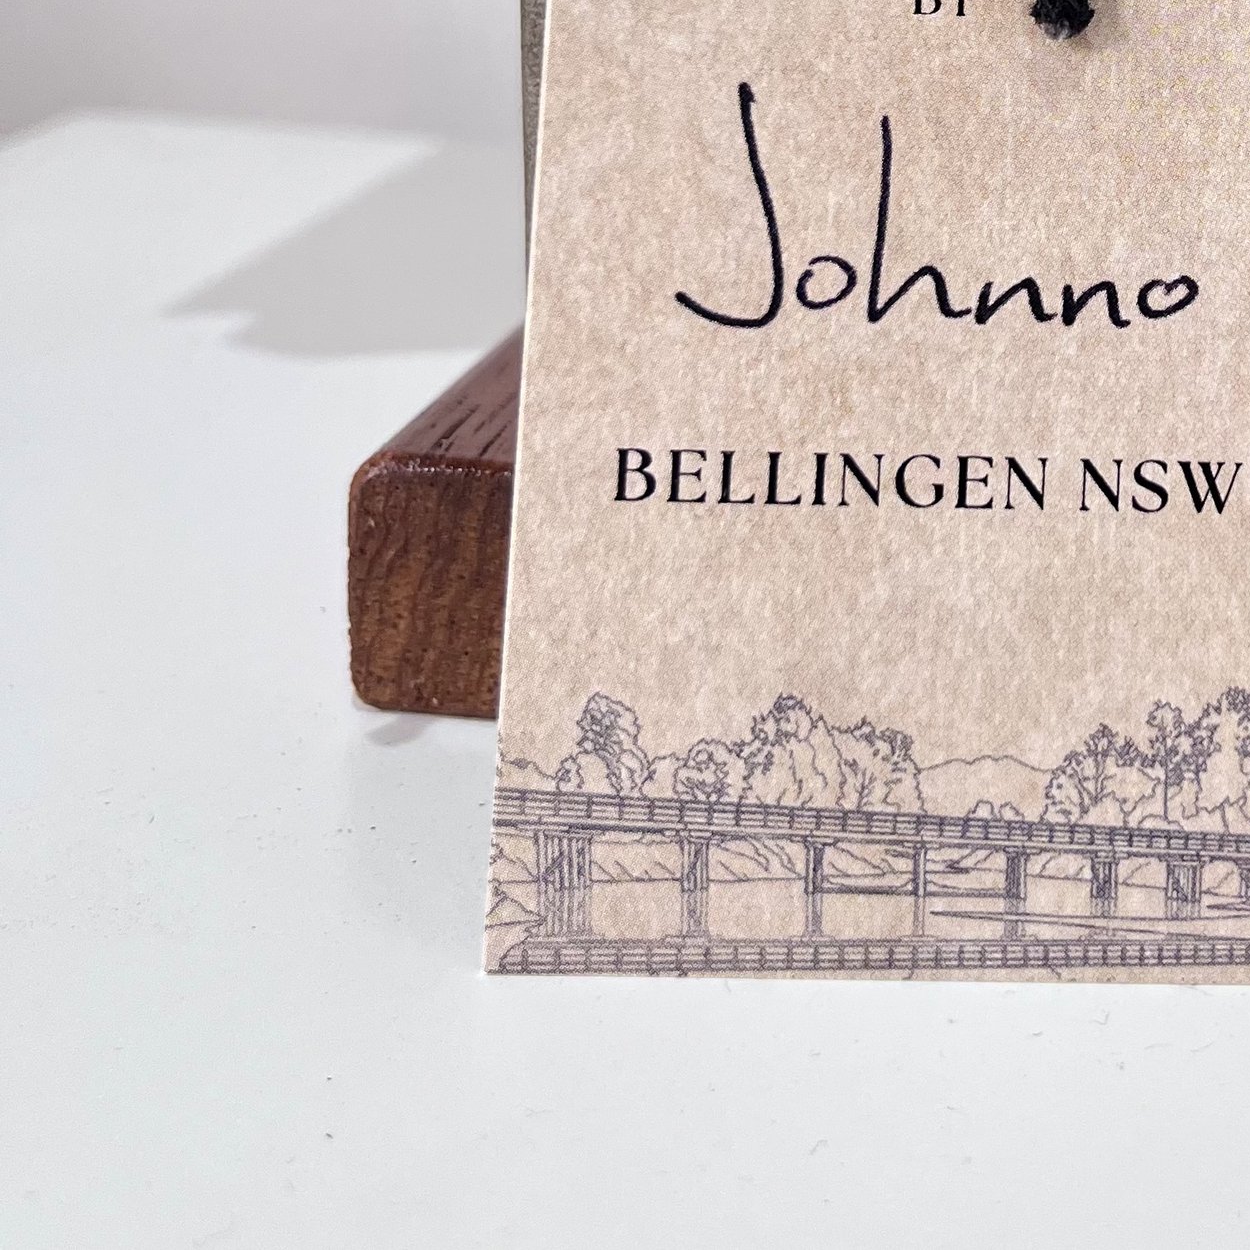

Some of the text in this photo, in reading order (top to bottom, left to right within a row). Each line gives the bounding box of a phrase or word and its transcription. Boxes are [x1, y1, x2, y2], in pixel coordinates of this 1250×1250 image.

[675, 82, 1199, 329] Johnno
[613, 448, 1243, 516] BELLINGEN NSW
